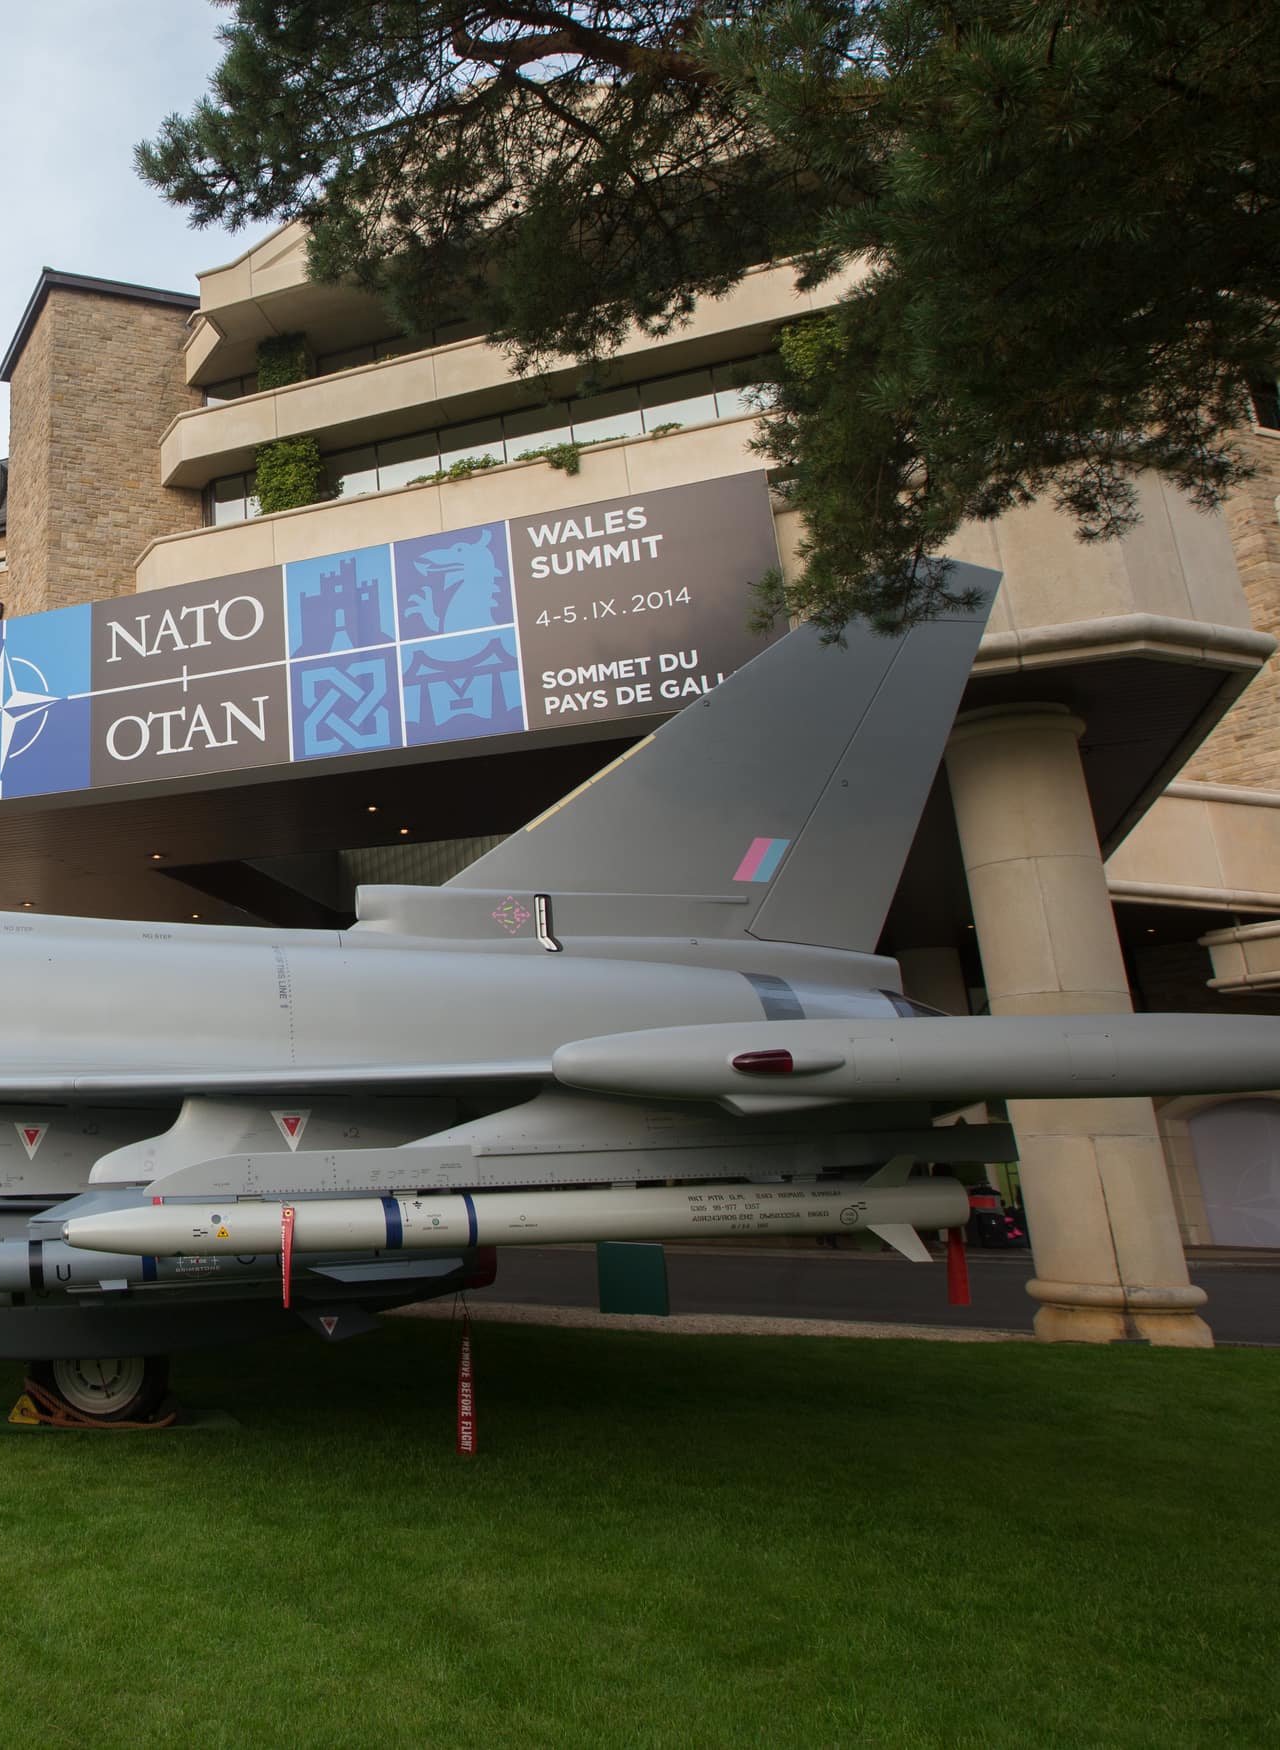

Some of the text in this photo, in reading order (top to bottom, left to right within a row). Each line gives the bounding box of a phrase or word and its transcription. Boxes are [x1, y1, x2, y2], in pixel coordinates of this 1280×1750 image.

[527, 506, 648, 548] WALES
[531, 534, 663, 579] SUMMIT
[106, 595, 265, 663] NATO
[542, 649, 698, 689] SOMMET DU
[544, 689, 609, 715] PAYS
[616, 683, 653, 705] DE
[106, 695, 269, 761] OTAN
[278, 981, 288, 999] LINE
[460, 1340, 473, 1452] REMOVE BEFORE FLIGHT
